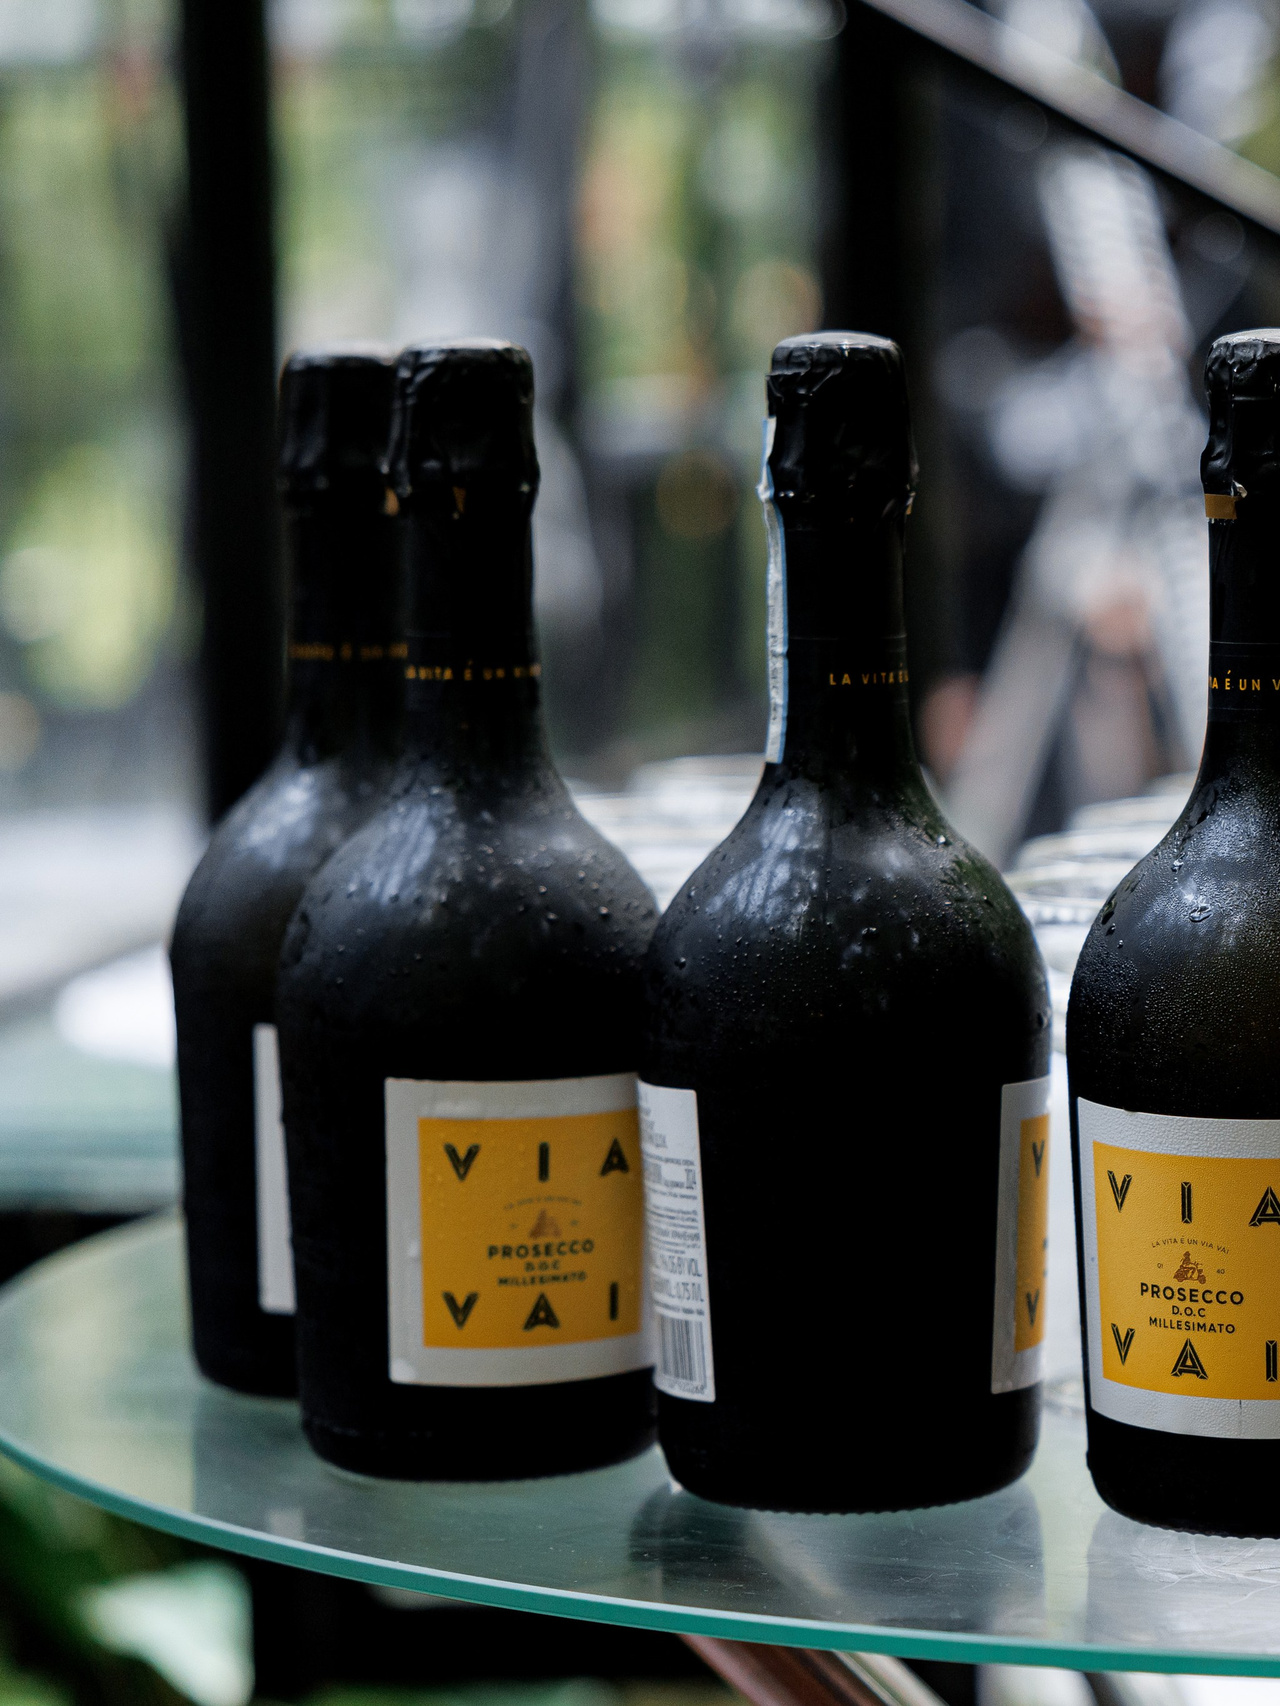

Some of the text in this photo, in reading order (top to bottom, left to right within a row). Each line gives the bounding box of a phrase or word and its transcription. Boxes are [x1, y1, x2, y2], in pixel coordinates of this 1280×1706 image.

[829, 673, 851, 686] LA
[861, 671, 895, 685] VITA
[1224, 669, 1231, 690] É
[1239, 679, 1261, 691] UN
[443, 1137, 629, 1182] VIA
[488, 1239, 595, 1260] PROSECCO
[1201, 1241, 1214, 1249] VIA
[1216, 1245, 1230, 1255] VAI
[1140, 1282, 1244, 1305] PROSECCO
[442, 1281, 619, 1332] VAI
[1171, 1305, 1206, 1318] D.O.C
[1149, 1316, 1235, 1334] MILLESIMATO
[1110, 1322, 1278, 1382] VAI
